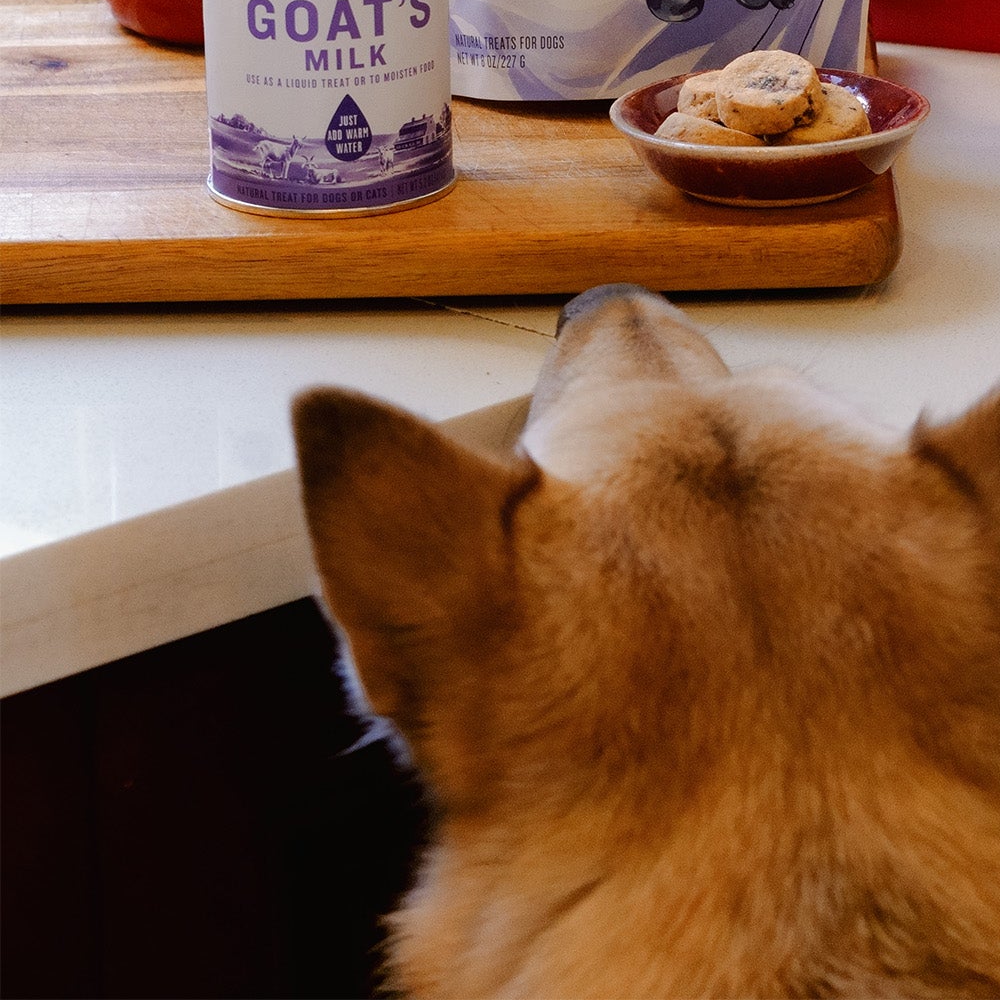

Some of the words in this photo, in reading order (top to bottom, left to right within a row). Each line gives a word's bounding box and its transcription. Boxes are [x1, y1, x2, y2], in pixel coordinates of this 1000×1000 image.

[455, 34, 483, 49] NATURAL
[484, 36, 517, 50] TREATS
[520, 36, 537, 50] FOR
[540, 35, 565, 49] DOGS
[305, 43, 387, 72] MILK
[457, 52, 469, 65] NET
[519, 55, 526, 69] G
[246, 73, 260, 85] USE
[263, 76, 274, 87] AS
[277, 78, 283, 87] A
[286, 78, 317, 89] LIQUID
[321, 77, 350, 88] TREAT
[354, 76, 366, 86] OR
[369, 74, 380, 84] TO
[383, 66, 418, 82] MOISTEN
[339, 115, 358, 126] JUST
[327, 129, 343, 141] ADD
[345, 127, 369, 140] WARM
[335, 141, 363, 154] WATER
[236, 185, 269, 200] NATURAL
[271, 188, 298, 203] TREAT
[301, 190, 318, 203] FOR
[322, 189, 347, 203] DOGS
[351, 189, 363, 202] OR
[366, 187, 387, 200] CATS
